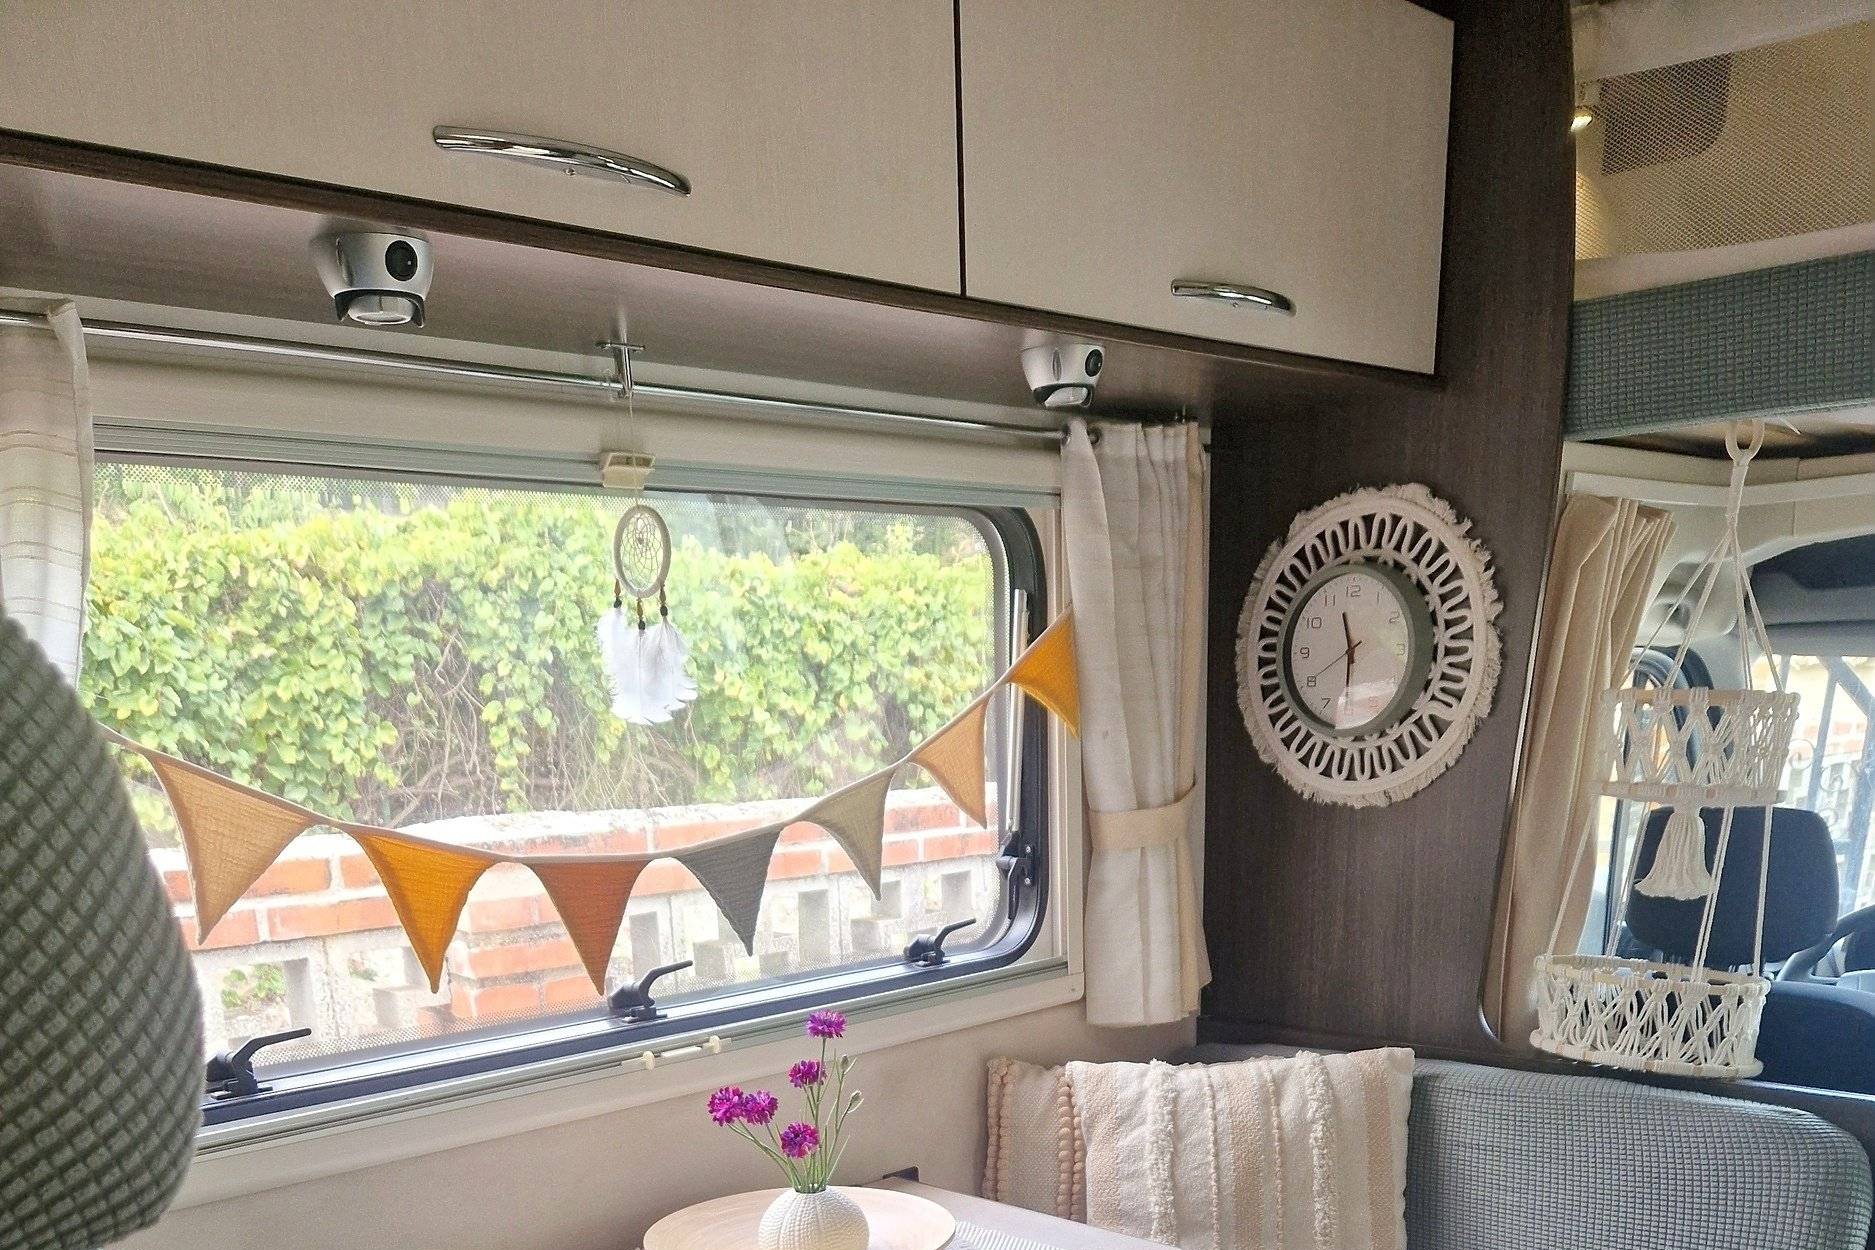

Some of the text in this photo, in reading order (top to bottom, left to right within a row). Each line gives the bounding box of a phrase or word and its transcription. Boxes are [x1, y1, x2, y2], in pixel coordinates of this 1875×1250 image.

[1346, 584, 1361, 597] 12
[1324, 594, 1336, 607] 11
[1306, 616, 1322, 629] 10
[1389, 611, 1399, 623] 2
[1300, 647, 1310, 659] 9
[1396, 643, 1405, 656] 3
[1307, 676, 1317, 687] 8
[1321, 697, 1332, 711] 7
